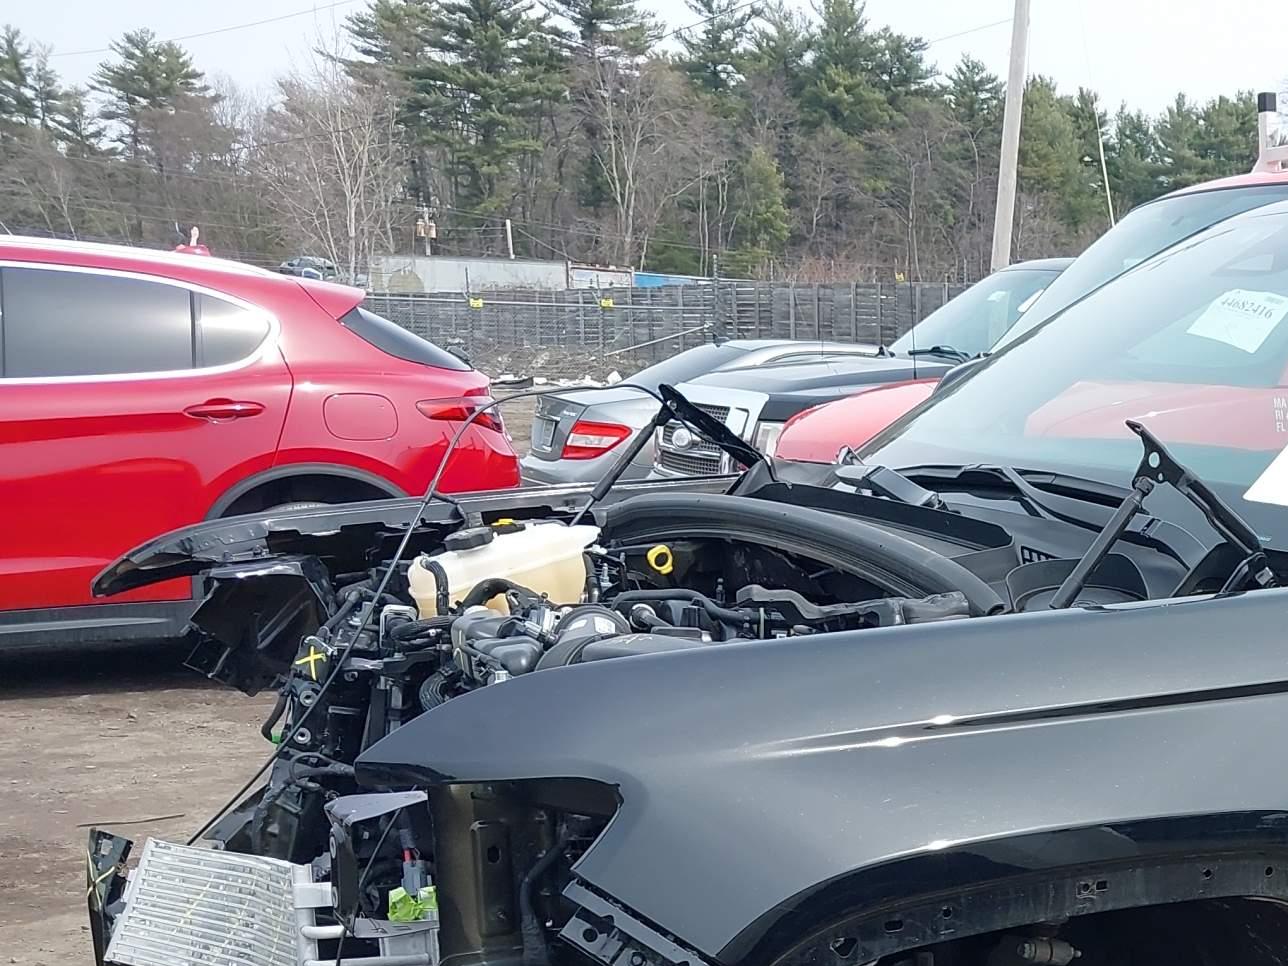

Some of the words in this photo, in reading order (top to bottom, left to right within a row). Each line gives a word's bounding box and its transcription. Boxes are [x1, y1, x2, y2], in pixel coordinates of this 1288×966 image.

[1221, 297, 1273, 320] 44682416
[1273, 397, 1287, 409] MA
[1275, 409, 1284, 420] RI
[1276, 421, 1286, 433] FL
